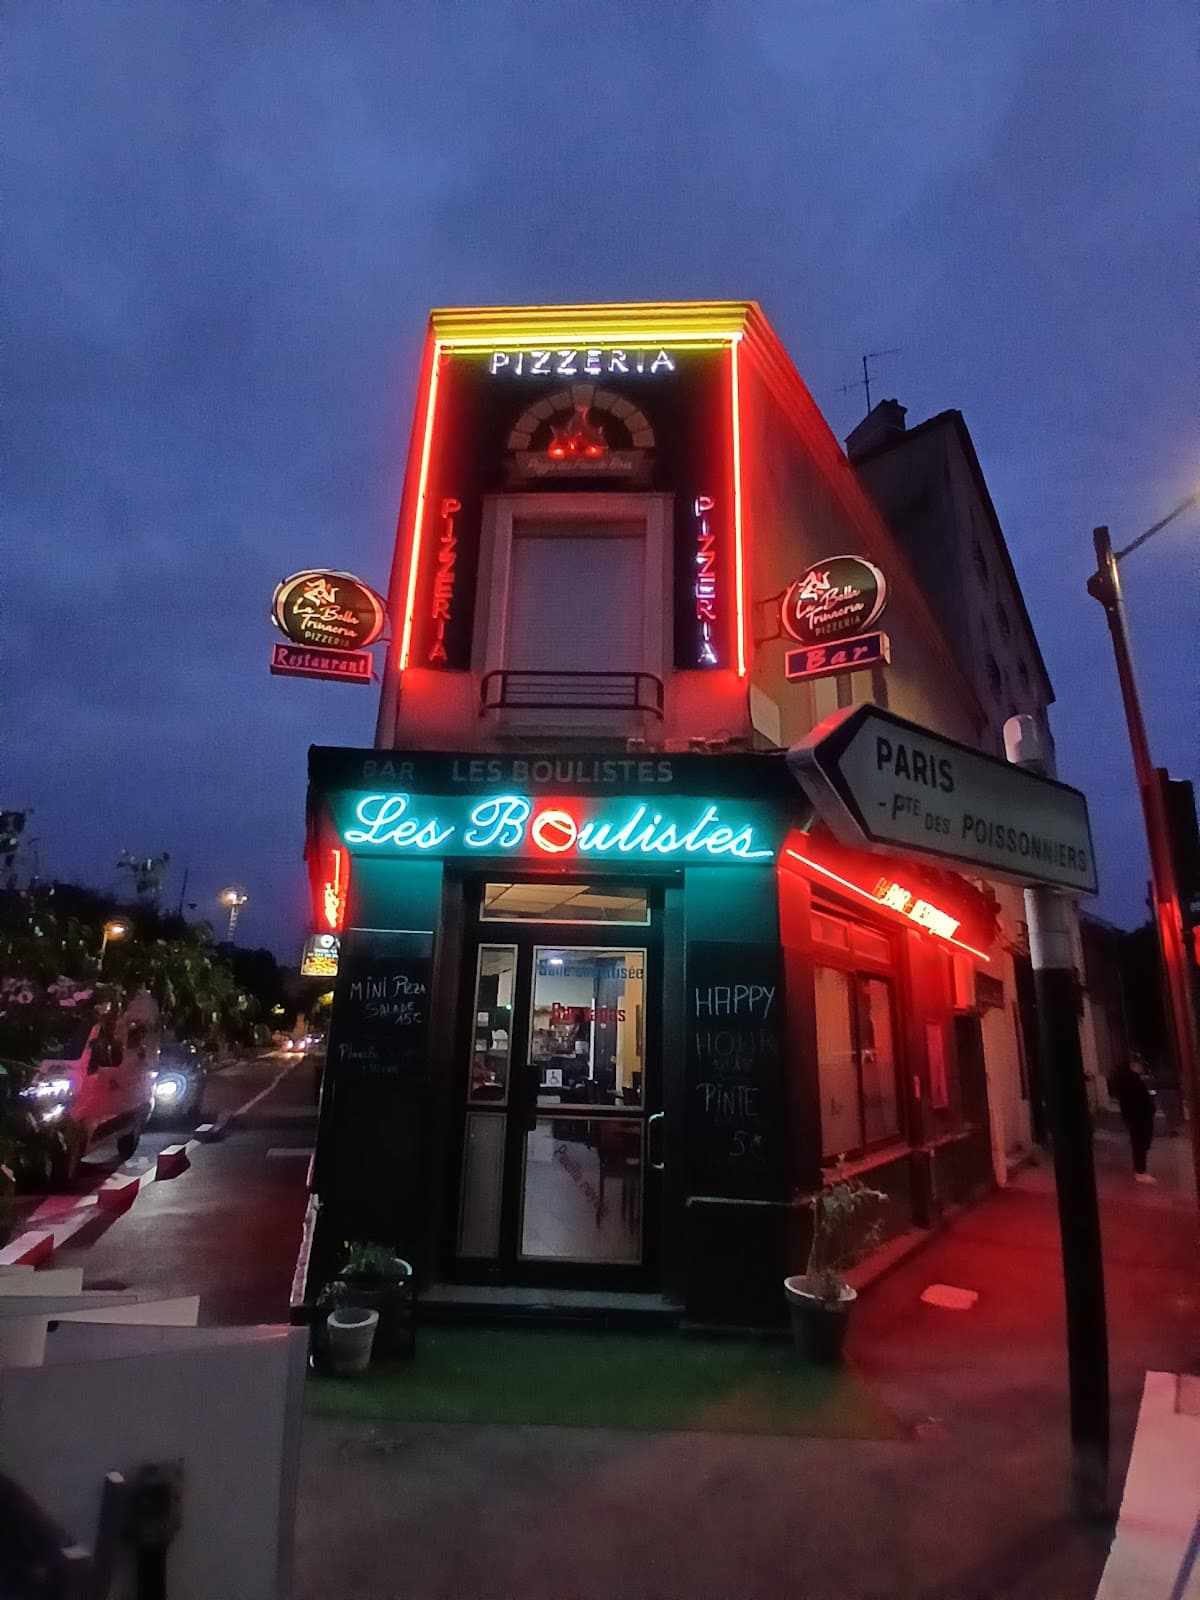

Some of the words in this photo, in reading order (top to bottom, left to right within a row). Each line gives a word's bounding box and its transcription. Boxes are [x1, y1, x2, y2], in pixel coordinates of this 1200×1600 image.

[489, 350, 676, 376] PIZZERIA
[429, 498, 462, 662] PIZZERIA
[694, 496, 718, 664] PIZZERIA
[293, 597, 315, 614] La
[304, 630, 351, 648] PIZZERIA
[815, 615, 862, 637] PIZZERIA
[806, 645, 869, 671] Bar
[361, 759, 416, 783] BAR
[450, 759, 504, 783] LES
[511, 759, 674, 784] BOULISTES
[876, 736, 955, 793] PARIS
[343, 793, 457, 850] Les
[925, 811, 950, 835] DES
[961, 813, 1088, 873] POISSONNIERS
[695, 984, 776, 1020] HAPPY
